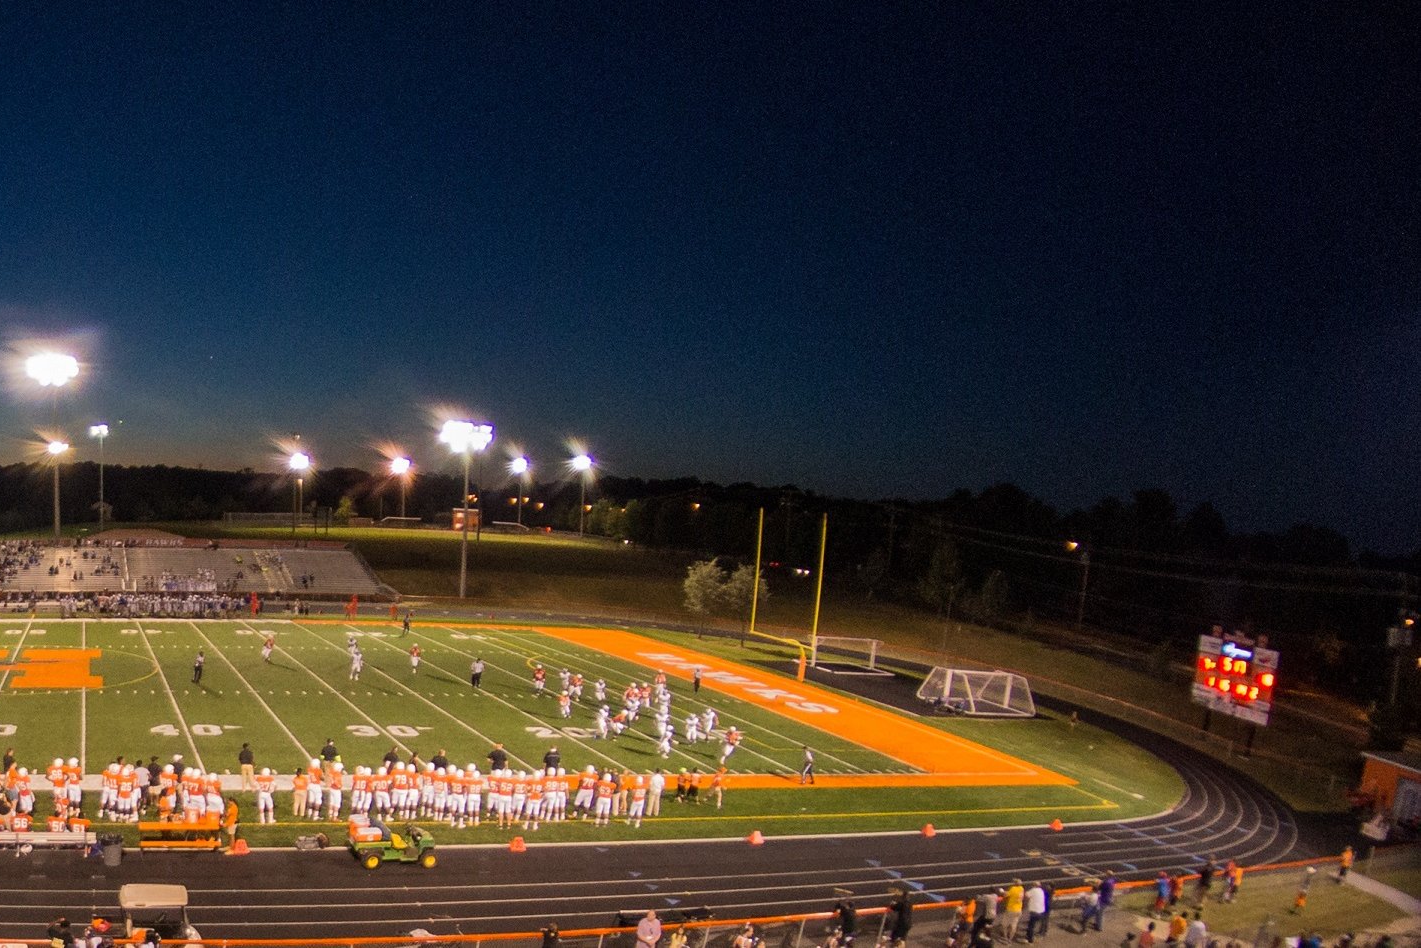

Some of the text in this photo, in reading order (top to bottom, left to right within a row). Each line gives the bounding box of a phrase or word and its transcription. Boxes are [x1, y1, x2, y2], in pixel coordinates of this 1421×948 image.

[150, 724, 224, 736] 40
[346, 725, 420, 737] 30
[14, 818, 28, 830] 56
